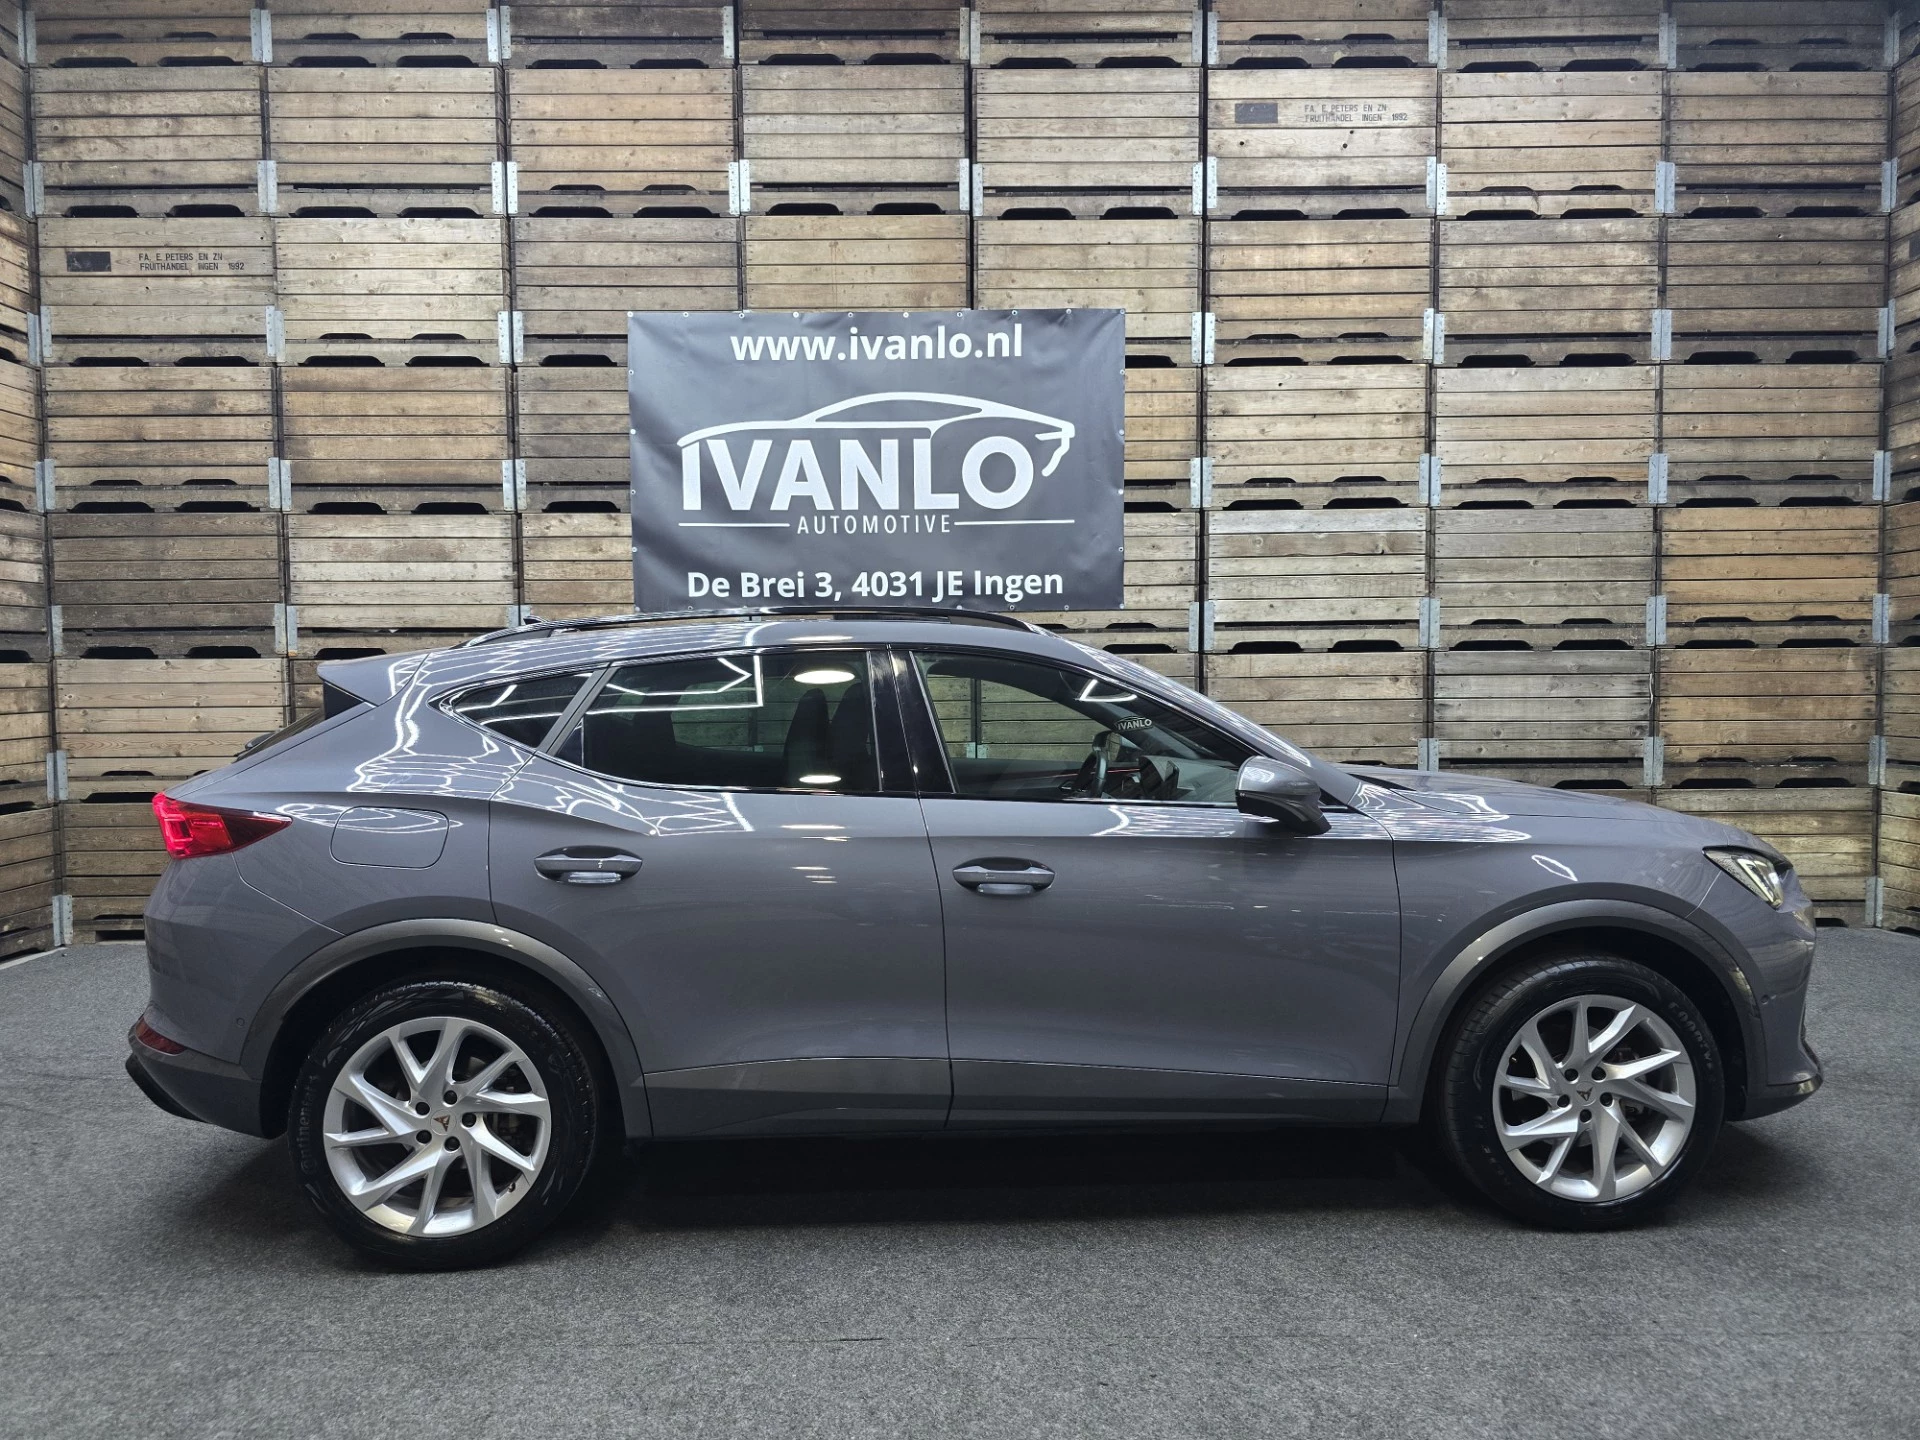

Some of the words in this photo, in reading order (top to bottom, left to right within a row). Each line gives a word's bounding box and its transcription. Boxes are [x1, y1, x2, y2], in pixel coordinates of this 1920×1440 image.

[1331, 104, 1359, 112] PETERS
[1363, 103, 1373, 112] EN
[1377, 103, 1387, 112] ZN
[1304, 113, 1354, 122] FRUITHANDEL
[1361, 113, 1383, 122] INGEN
[1391, 112, 1408, 121] 1992
[165, 252, 194, 261] PETERS
[198, 252, 209, 261] EN
[212, 252, 223, 261] ZN
[139, 262, 190, 271] FRUITHANDEL
[197, 262, 219, 271] INGEN
[730, 323, 1023, 361] www.ivanlo.nl
[681, 434, 1035, 511] IVANLO
[797, 514, 951, 535] AUTOMOTIVE
[687, 571, 731, 598] De
[740, 570, 806, 599] Brei
[814, 571, 843, 602] 3,
[851, 570, 924, 598] 4031
[931, 570, 963, 603] JE
[974, 569, 1064, 603] Ingen
[1117, 718, 1153, 730] IVANLO
